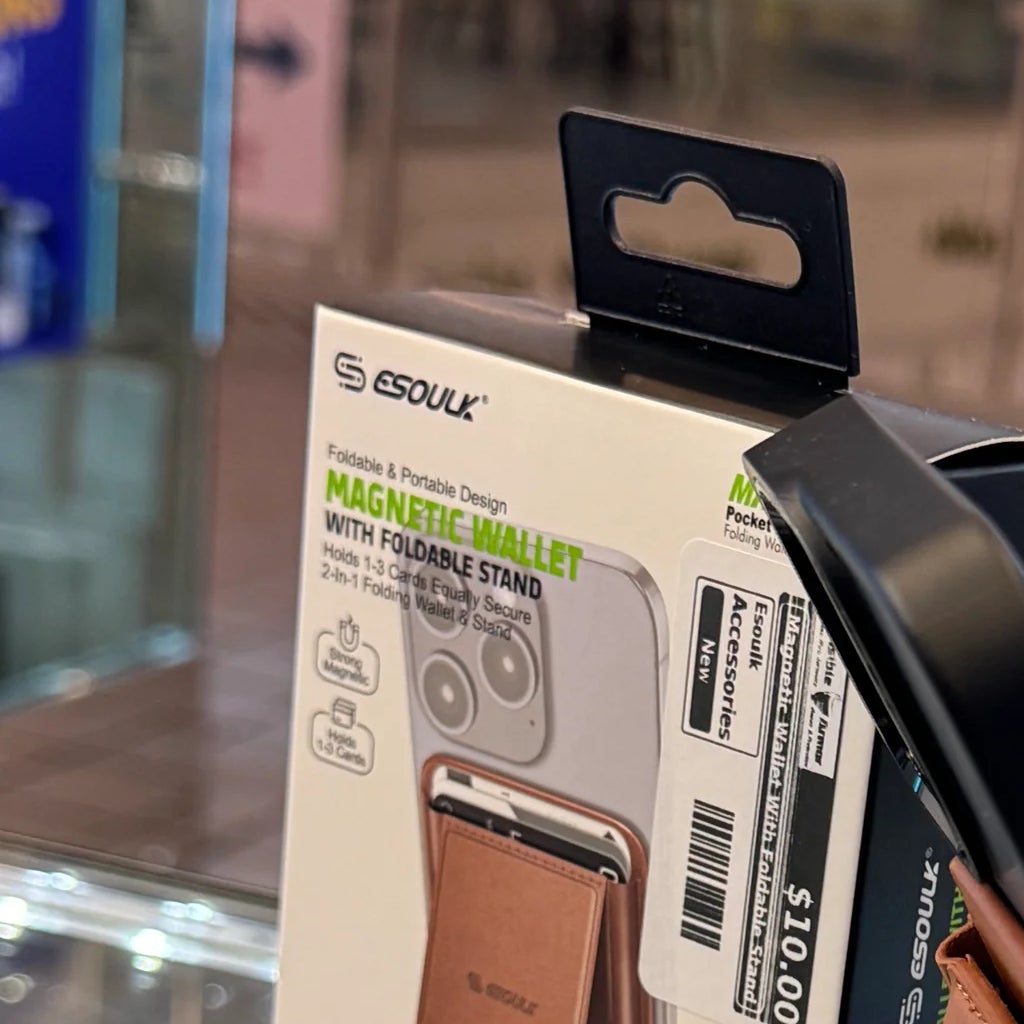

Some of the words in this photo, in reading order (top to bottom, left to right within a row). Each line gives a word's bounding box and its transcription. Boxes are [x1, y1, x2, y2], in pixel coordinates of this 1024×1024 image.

[328, 444, 383, 476] Foldable
[387, 463, 397, 480] &
[401, 466, 457, 498] Portable
[460, 484, 508, 516] Design
[728, 473, 760, 508] M
[325, 468, 464, 544] MAGNETIC
[472, 514, 585, 582] WALLET
[723, 523, 761, 551] Folding
[764, 535, 786, 555] Wa
[726, 505, 772, 533] Pocket
[323, 541, 360, 568] Holds
[364, 555, 385, 577] 1-3
[388, 563, 428, 591] Cards
[431, 576, 480, 611] Equally
[484, 595, 532, 625] Secure
[325, 510, 374, 546] WITH
[381, 528, 474, 578] FOLDABLE
[479, 561, 542, 600] STAND
[321, 563, 359, 589] 2-In-1
[363, 576, 411, 611] Folding
[415, 594, 456, 622] Wallet
[459, 610, 469, 626] &
[472, 613, 512, 641] Stand
[329, 647, 363, 673] Strong
[698, 638, 716, 684] New
[718, 593, 748, 742] Accessories
[749, 601, 768, 672] Esoulk
[777, 617, 800, 717] Magnetic
[323, 659, 370, 687] Magnetic
[328, 728, 357, 751] Holds
[336, 745, 366, 768] Cards
[767, 722, 789, 787] Wallet
[761, 797, 781, 841] With
[753, 850, 774, 936] Foldable
[744, 945, 763, 1004] Stand
